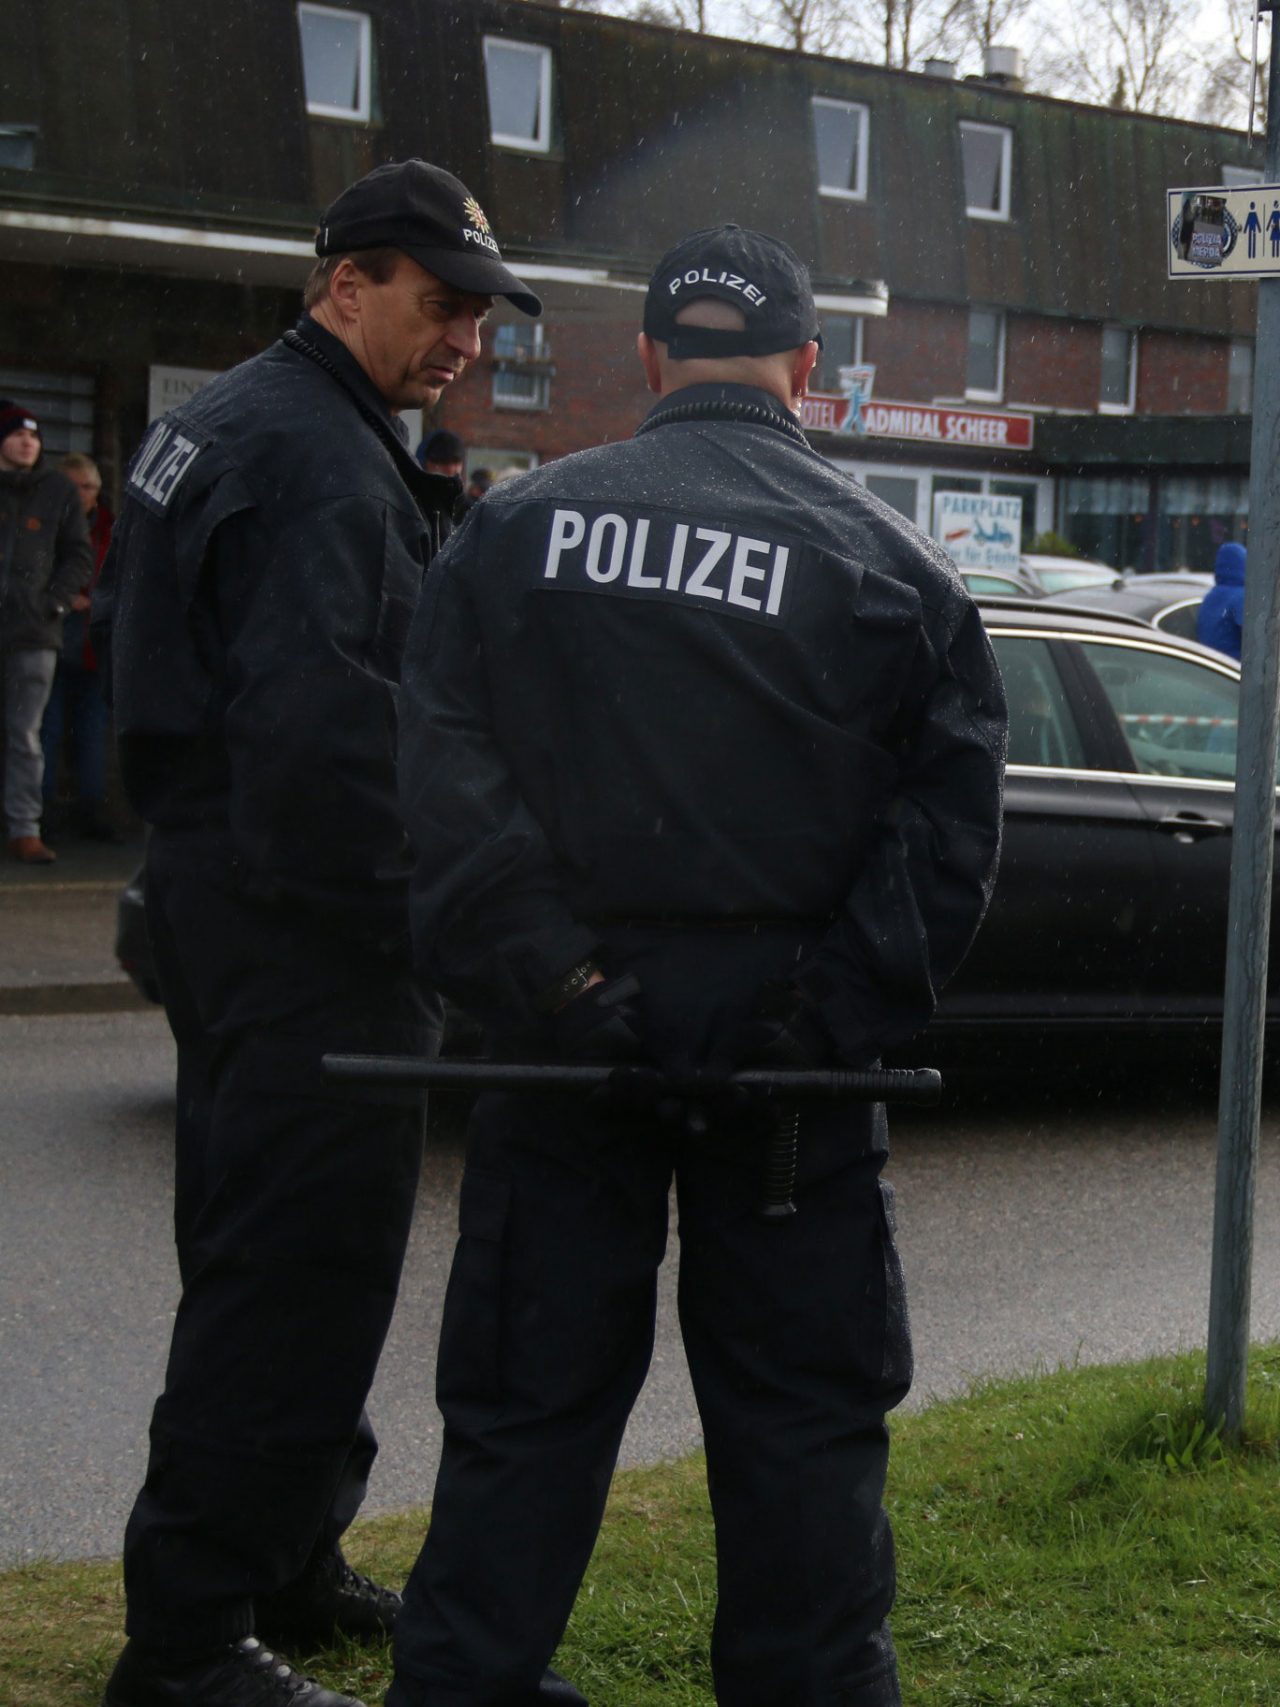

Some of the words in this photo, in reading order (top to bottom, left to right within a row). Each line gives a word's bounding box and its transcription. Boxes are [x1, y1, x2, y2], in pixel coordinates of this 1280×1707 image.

[668, 268, 767, 307] POLIZEI
[801, 401, 837, 427] OTEL
[864, 407, 942, 438] ADMIRAL
[944, 416, 1008, 444] SCHEER
[943, 496, 1020, 519] PARKPLATZ
[544, 509, 790, 616] POLIZEI
